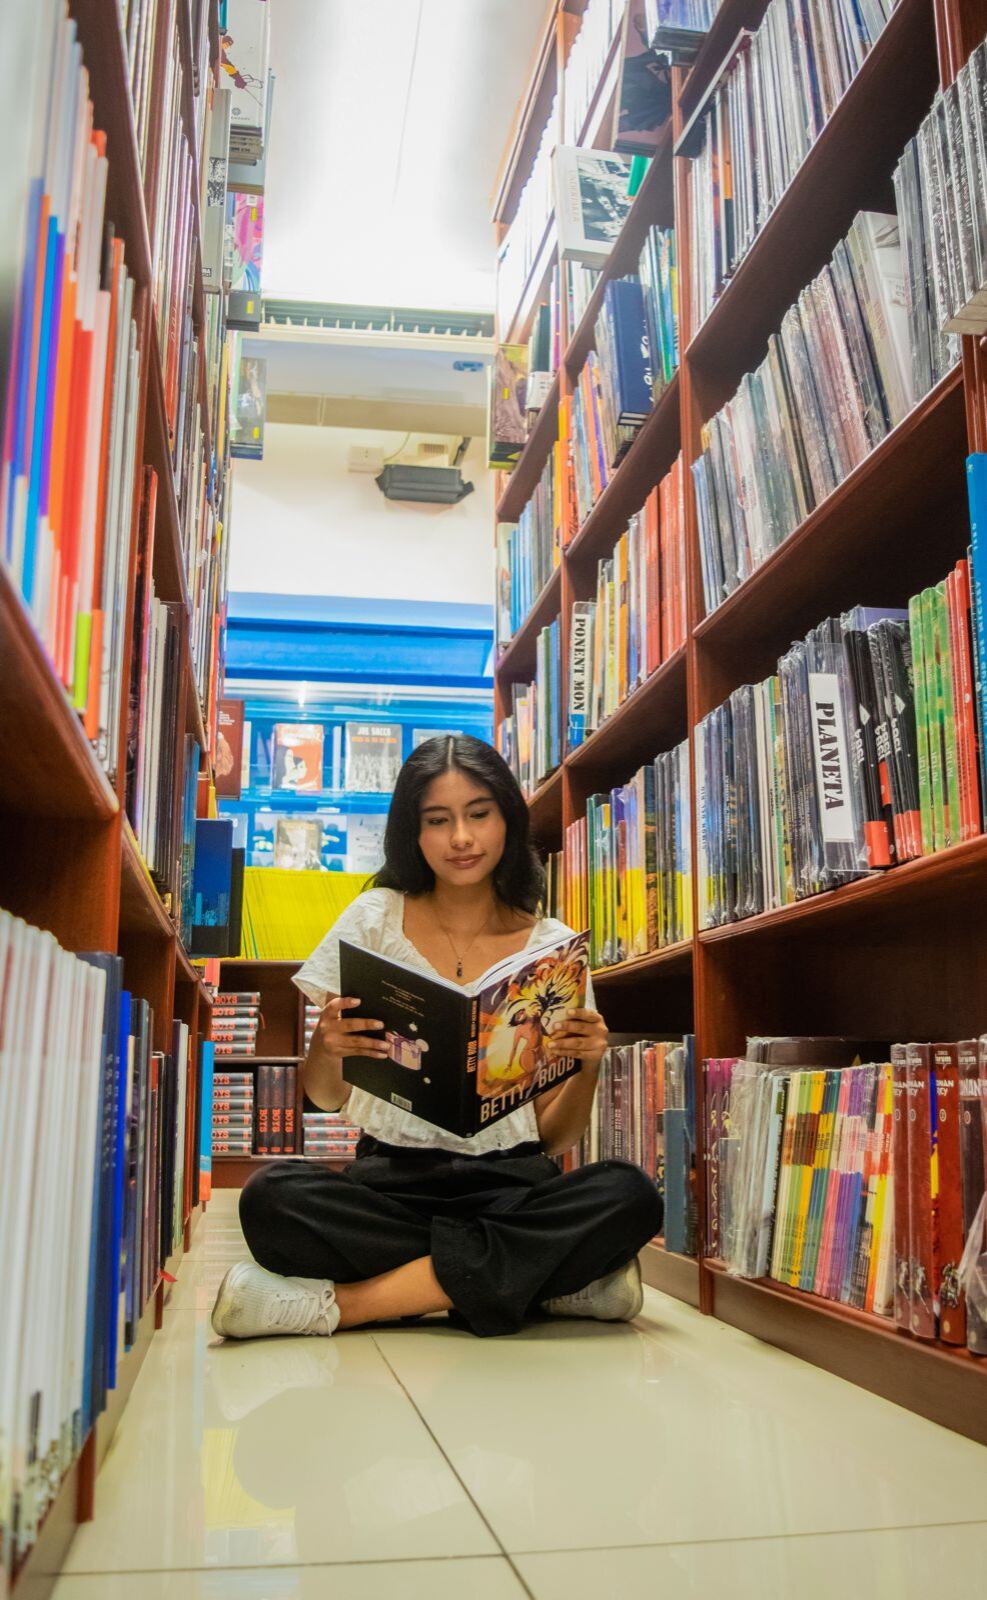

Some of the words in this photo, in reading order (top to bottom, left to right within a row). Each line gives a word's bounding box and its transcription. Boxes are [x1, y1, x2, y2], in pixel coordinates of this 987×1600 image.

[975, 580, 985, 634] MICKEY
[573, 617, 586, 676] PONENT
[573, 680, 585, 711] MON
[815, 701, 846, 811] PLANETA
[214, 1046, 232, 1054] OYS
[213, 1075, 230, 1085] OYS
[213, 1089, 230, 1098] OYS
[480, 1078, 527, 1123] BETTY
[538, 1056, 575, 1089] BOOB
[212, 1103, 230, 1112] OYS
[212, 1116, 230, 1125] OYS
[259, 1108, 268, 1133] BOYS
[271, 1108, 281, 1133] BOYS
[285, 1108, 294, 1133] BOYS
[212, 1130, 229, 1139] OYS
[347, 1130, 360, 1139] BO
[211, 1144, 229, 1153] OYS
